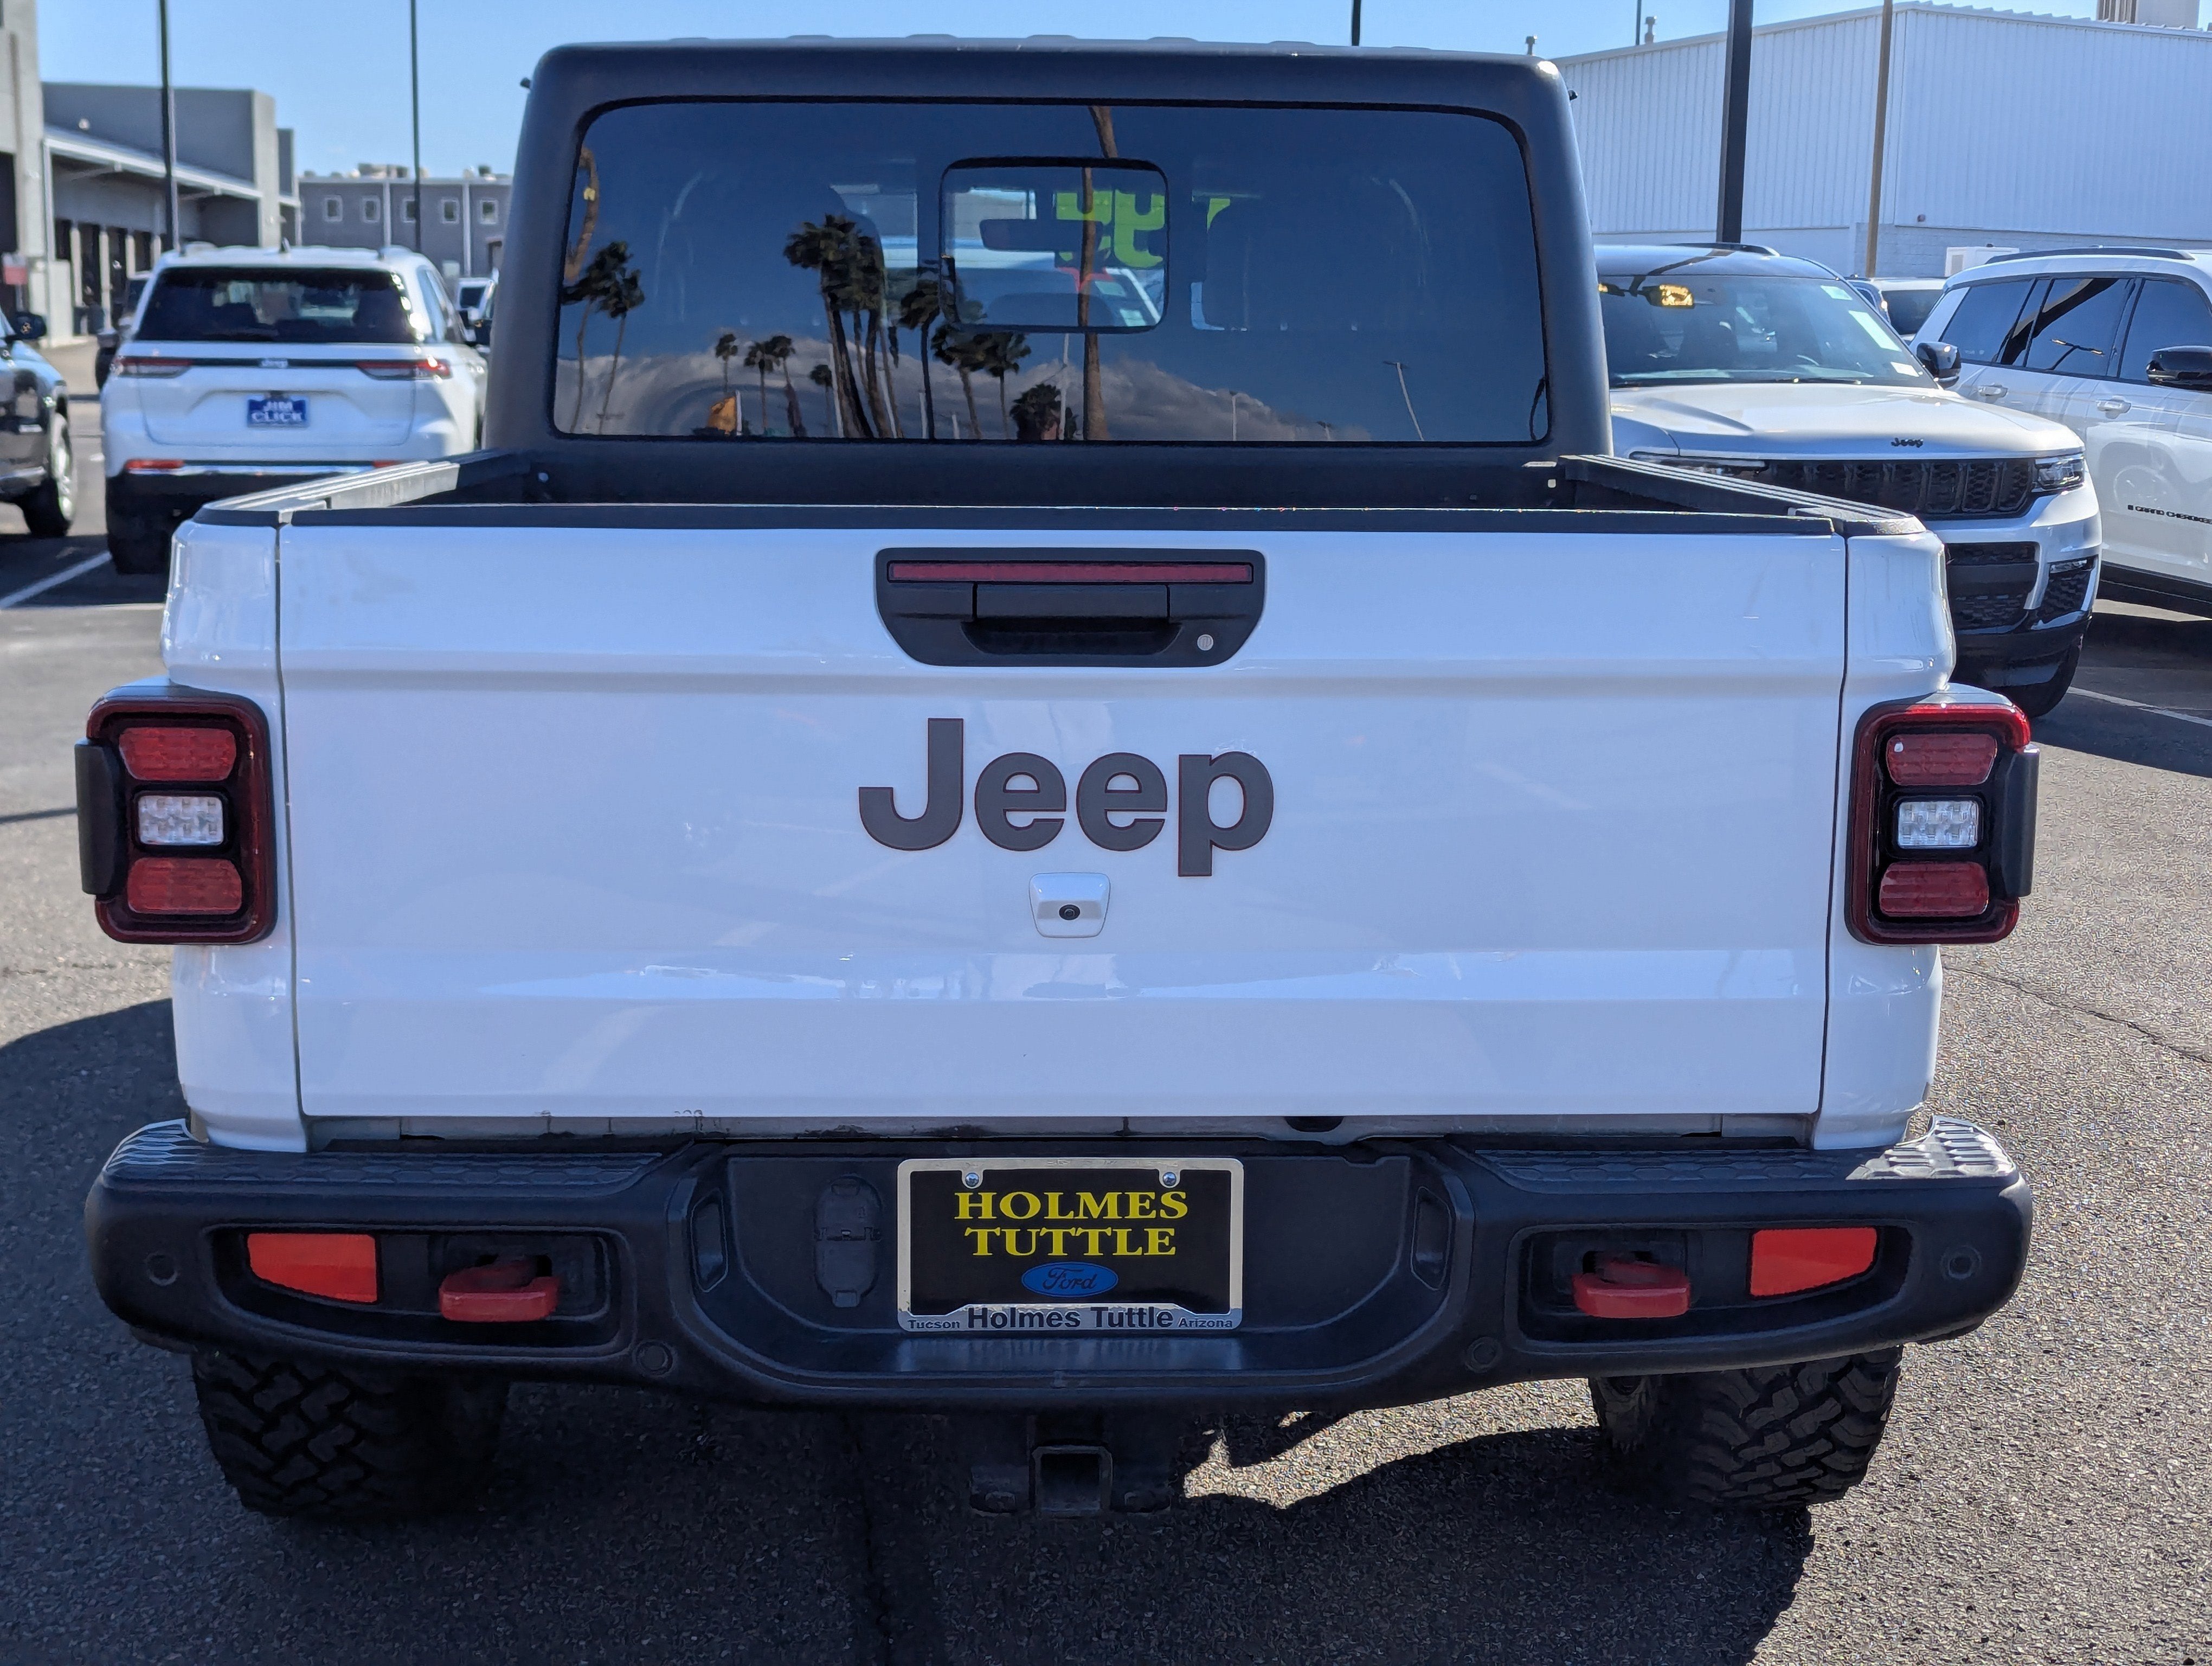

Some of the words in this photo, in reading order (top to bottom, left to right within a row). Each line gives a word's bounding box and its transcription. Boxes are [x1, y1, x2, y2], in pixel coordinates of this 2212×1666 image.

[263, 401, 293, 412] JIM
[1891, 438, 1924, 448] Jeep
[2135, 506, 2165, 516] GRAND
[859, 717, 1274, 877] Jeep
[954, 1191, 1188, 1220] HOLMES
[964, 1227, 1176, 1256] TUTTLE
[1042, 1268, 1097, 1291] Ford
[908, 1318, 960, 1329] Tucson
[968, 1306, 1081, 1329] Holmes
[1090, 1305, 1173, 1329] Tuttle
[1178, 1316, 1233, 1329] Arizona
